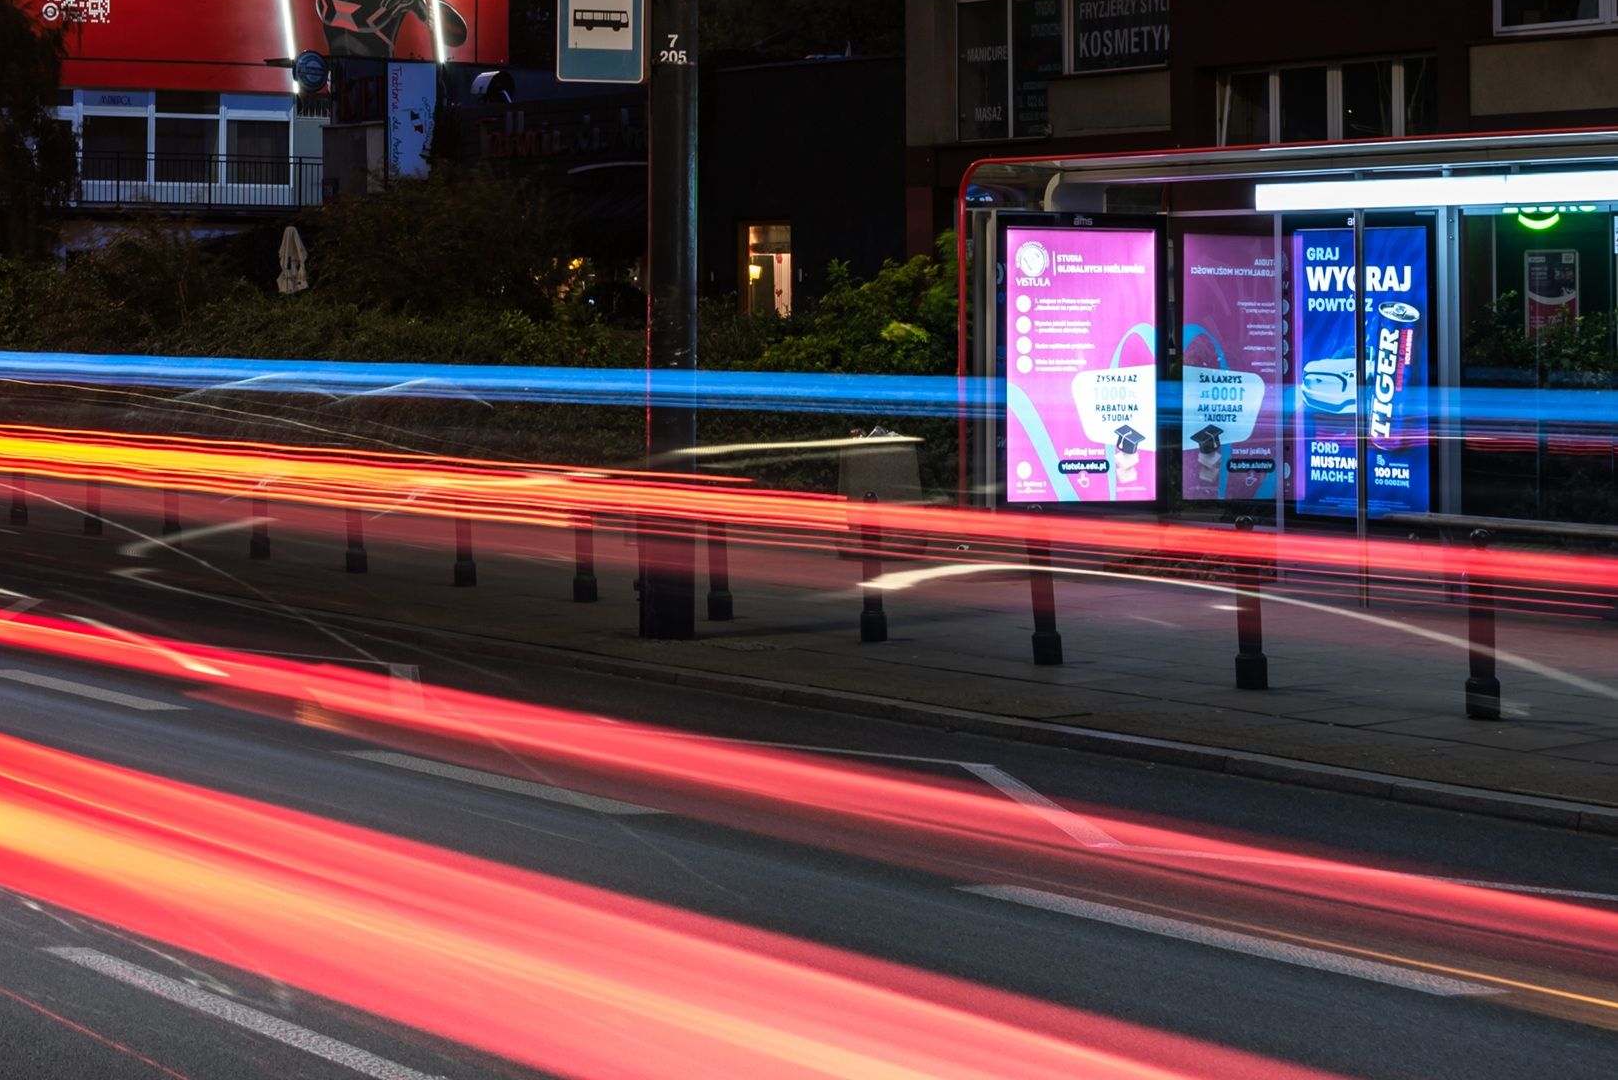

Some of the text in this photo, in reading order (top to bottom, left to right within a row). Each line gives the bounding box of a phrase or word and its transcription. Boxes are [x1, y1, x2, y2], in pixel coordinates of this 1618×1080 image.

[667, 34, 678, 48] 7
[660, 50, 687, 64] 205
[967, 45, 1008, 63] MANICURE
[974, 102, 1002, 121] MASAŻ
[1056, 254, 1083, 263] STUDIA
[1306, 247, 1340, 261] GRAJ
[1015, 277, 1051, 287] VISTULA
[1308, 294, 1373, 312] POWTÓZ
[1096, 374, 1126, 383] ZYSKAJ
[1371, 328, 1400, 439] TIGER
[1094, 387, 1127, 400] 1000
[1095, 404, 1139, 412] RABATU NA
[1311, 442, 1339, 454] FORD
[1061, 462, 1107, 471] vistula.edu.pl
[1310, 456, 1357, 469] MUSTAN
[1311, 470, 1354, 483] MACH-E
[1374, 467, 1409, 479] 100 PLN
